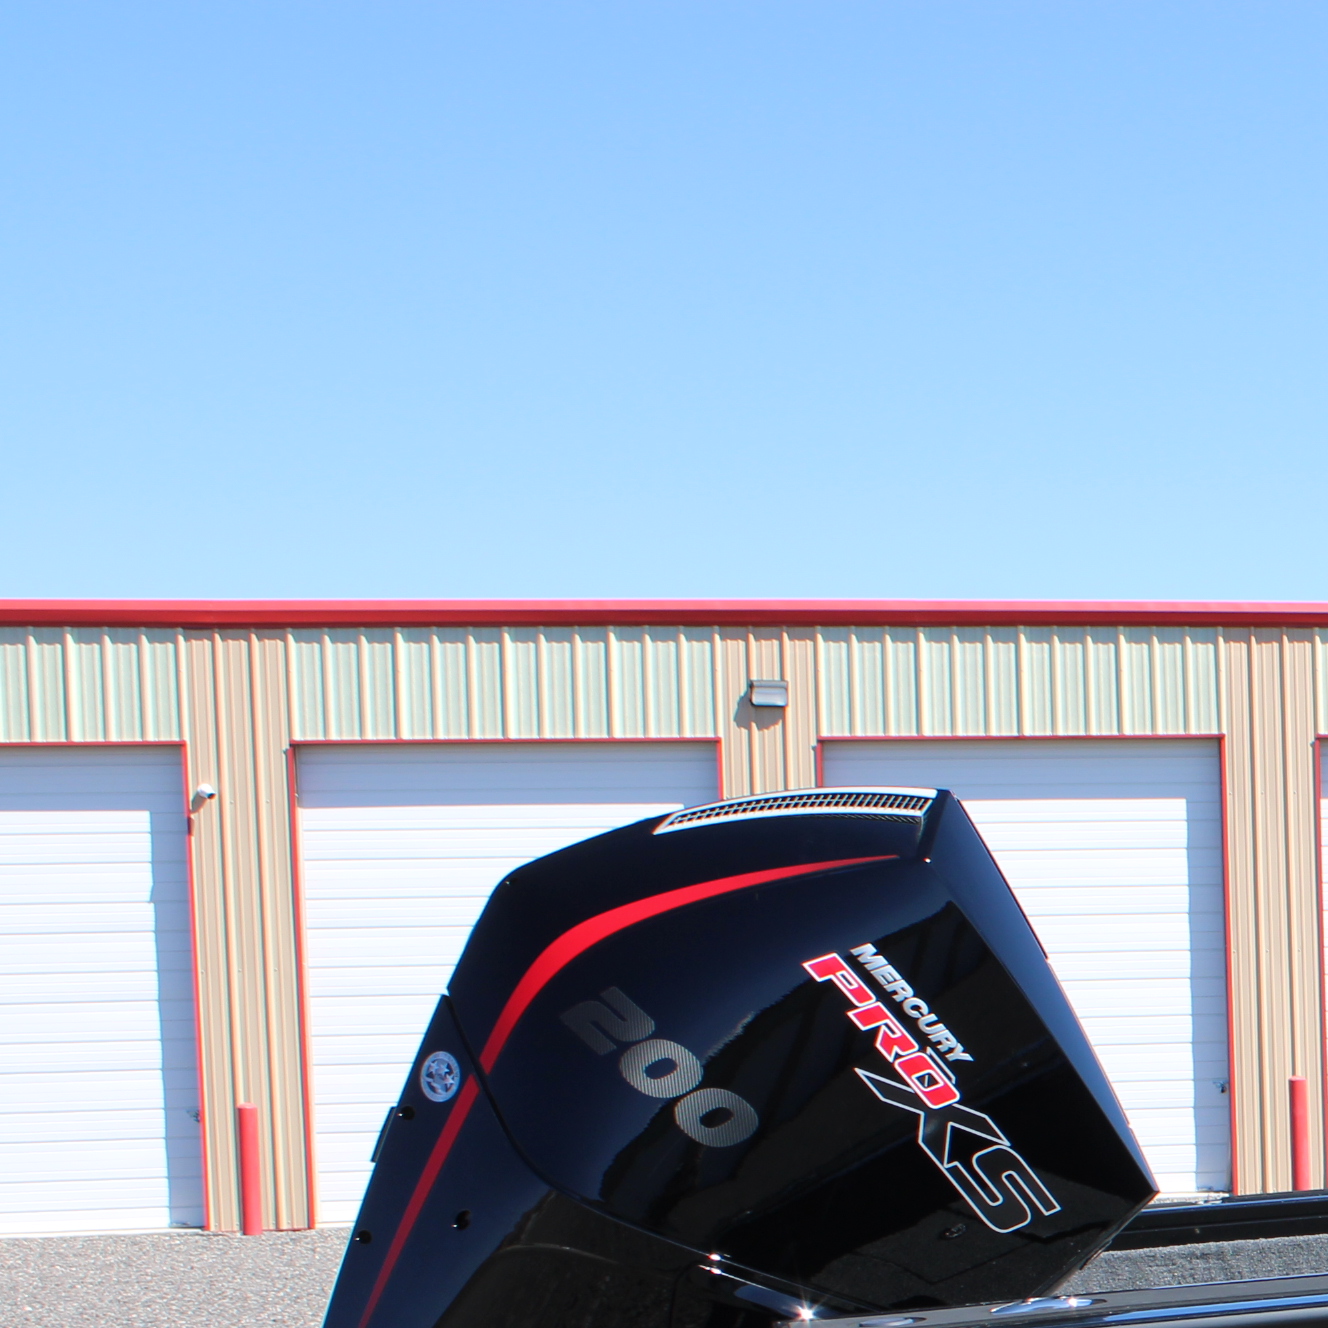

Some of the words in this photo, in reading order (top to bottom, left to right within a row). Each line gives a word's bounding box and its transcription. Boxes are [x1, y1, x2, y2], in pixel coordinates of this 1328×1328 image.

[561, 987, 758, 1147] 200
[803, 953, 960, 1109] PRO
[850, 943, 974, 1063] MERCURY
[855, 1067, 1061, 1232] XS
